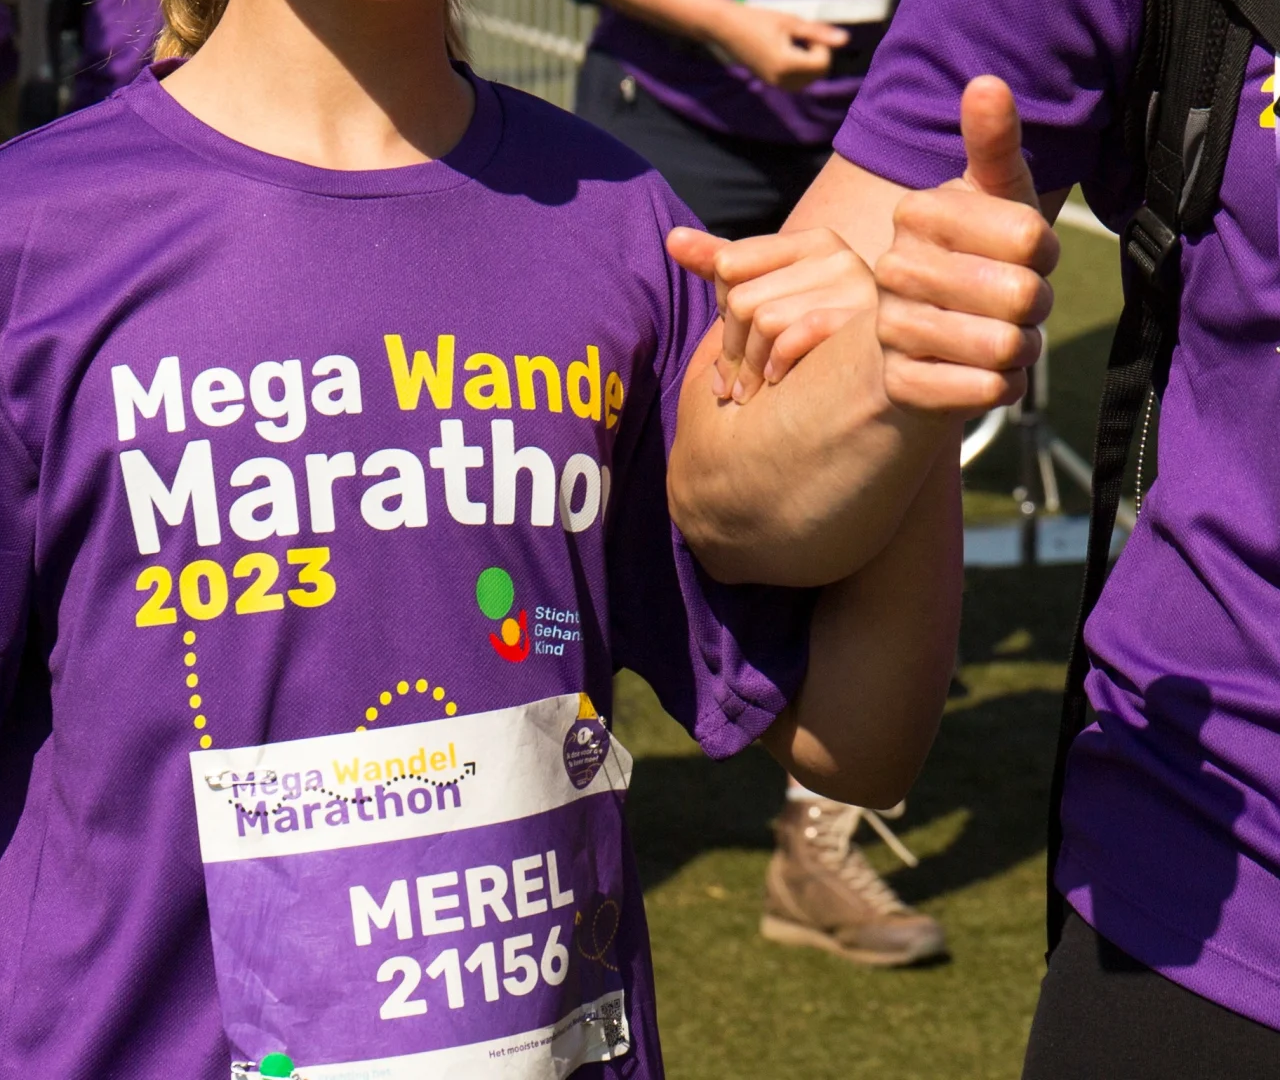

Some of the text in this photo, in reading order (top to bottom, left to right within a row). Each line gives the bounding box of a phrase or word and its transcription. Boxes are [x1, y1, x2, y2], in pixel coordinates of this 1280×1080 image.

[111, 334, 625, 443] Mega Wande
[135, 546, 336, 628] 2023
[535, 606, 580, 623] Sticht
[534, 623, 583, 642] Gehan
[534, 640, 564, 656] Kind
[231, 742, 458, 800] Mega Wandel
[234, 782, 462, 837] Marathon
[349, 850, 574, 947] MEREL
[376, 925, 569, 1020] 21156
[488, 1040, 540, 1059] Het mooiste
